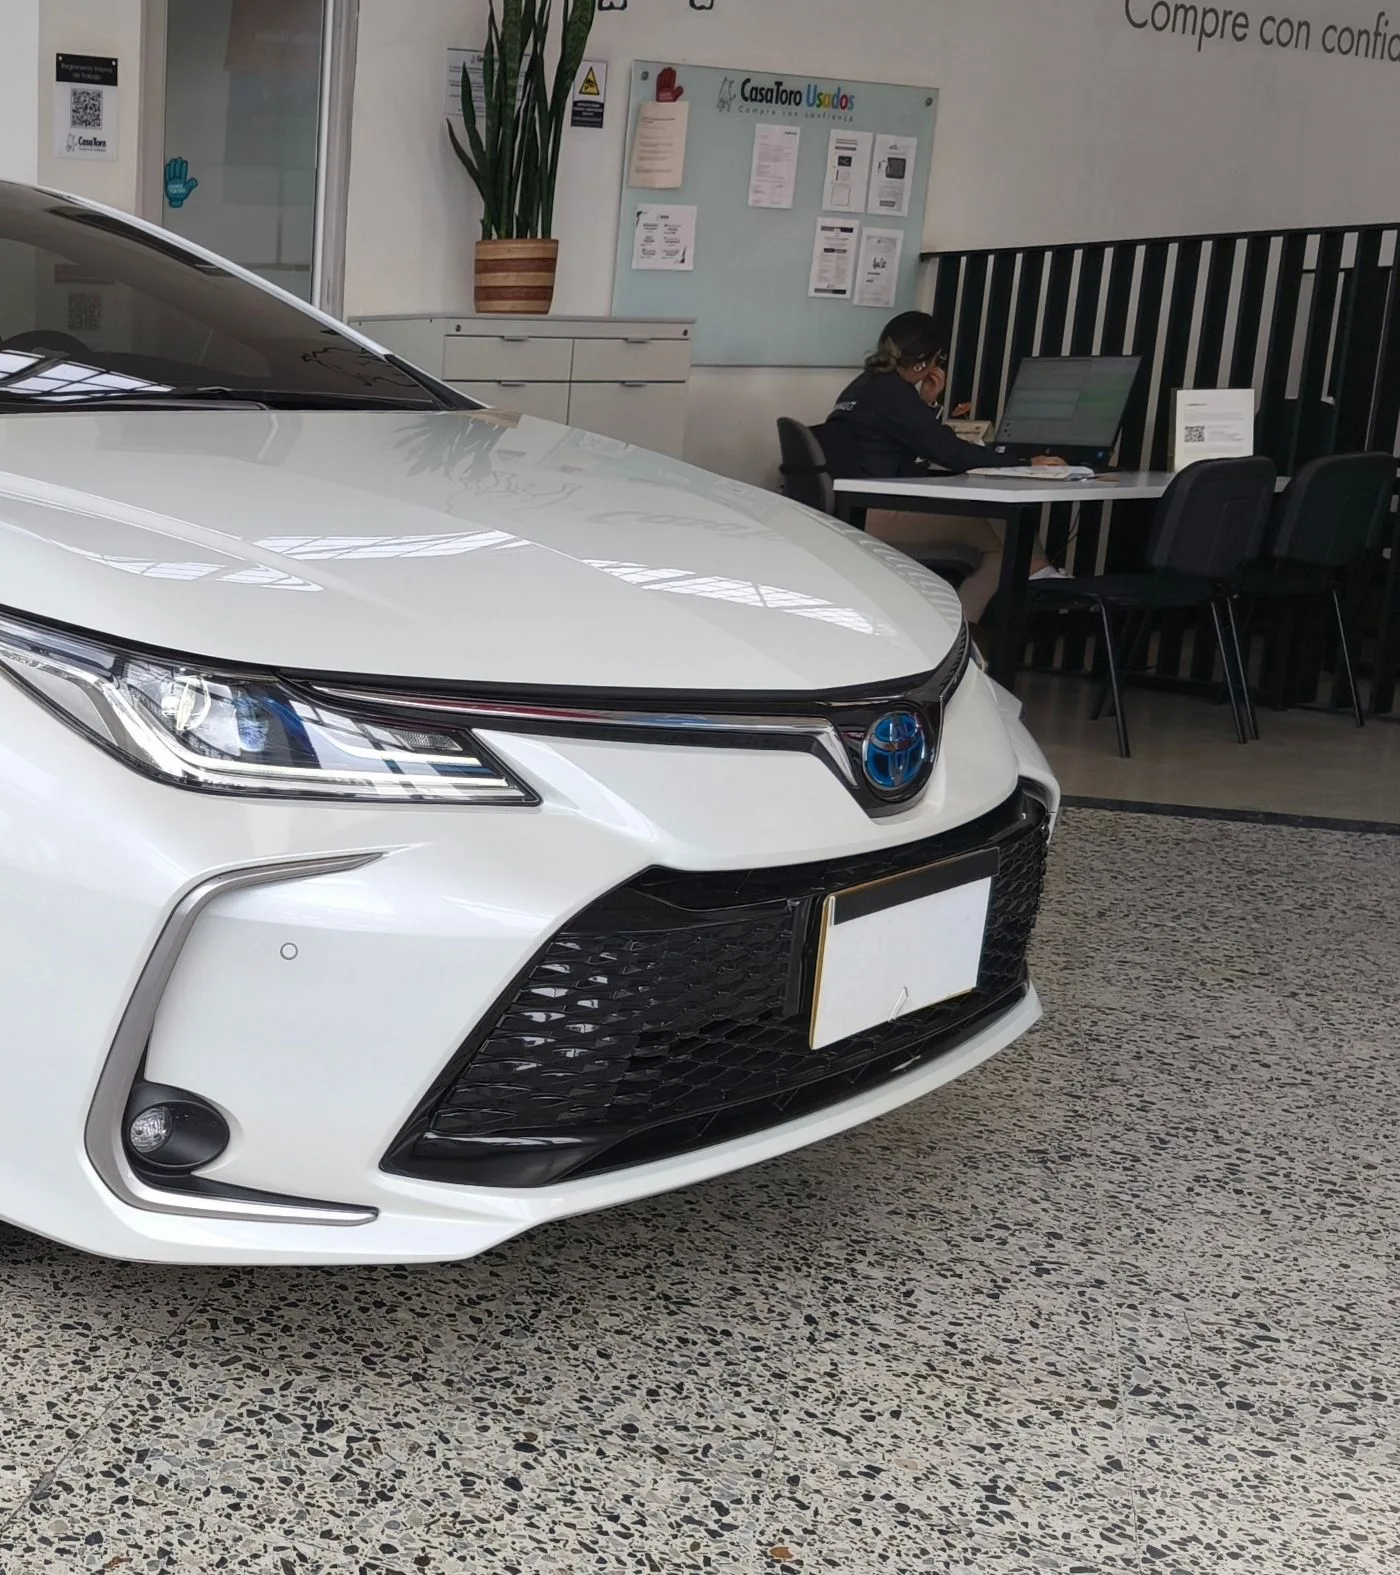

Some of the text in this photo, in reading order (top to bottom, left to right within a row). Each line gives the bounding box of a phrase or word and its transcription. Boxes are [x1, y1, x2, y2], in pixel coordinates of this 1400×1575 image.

[1125, 0, 1249, 52] Compre
[1260, 15, 1310, 50] con
[741, 78, 855, 111] CasaToro Usados
